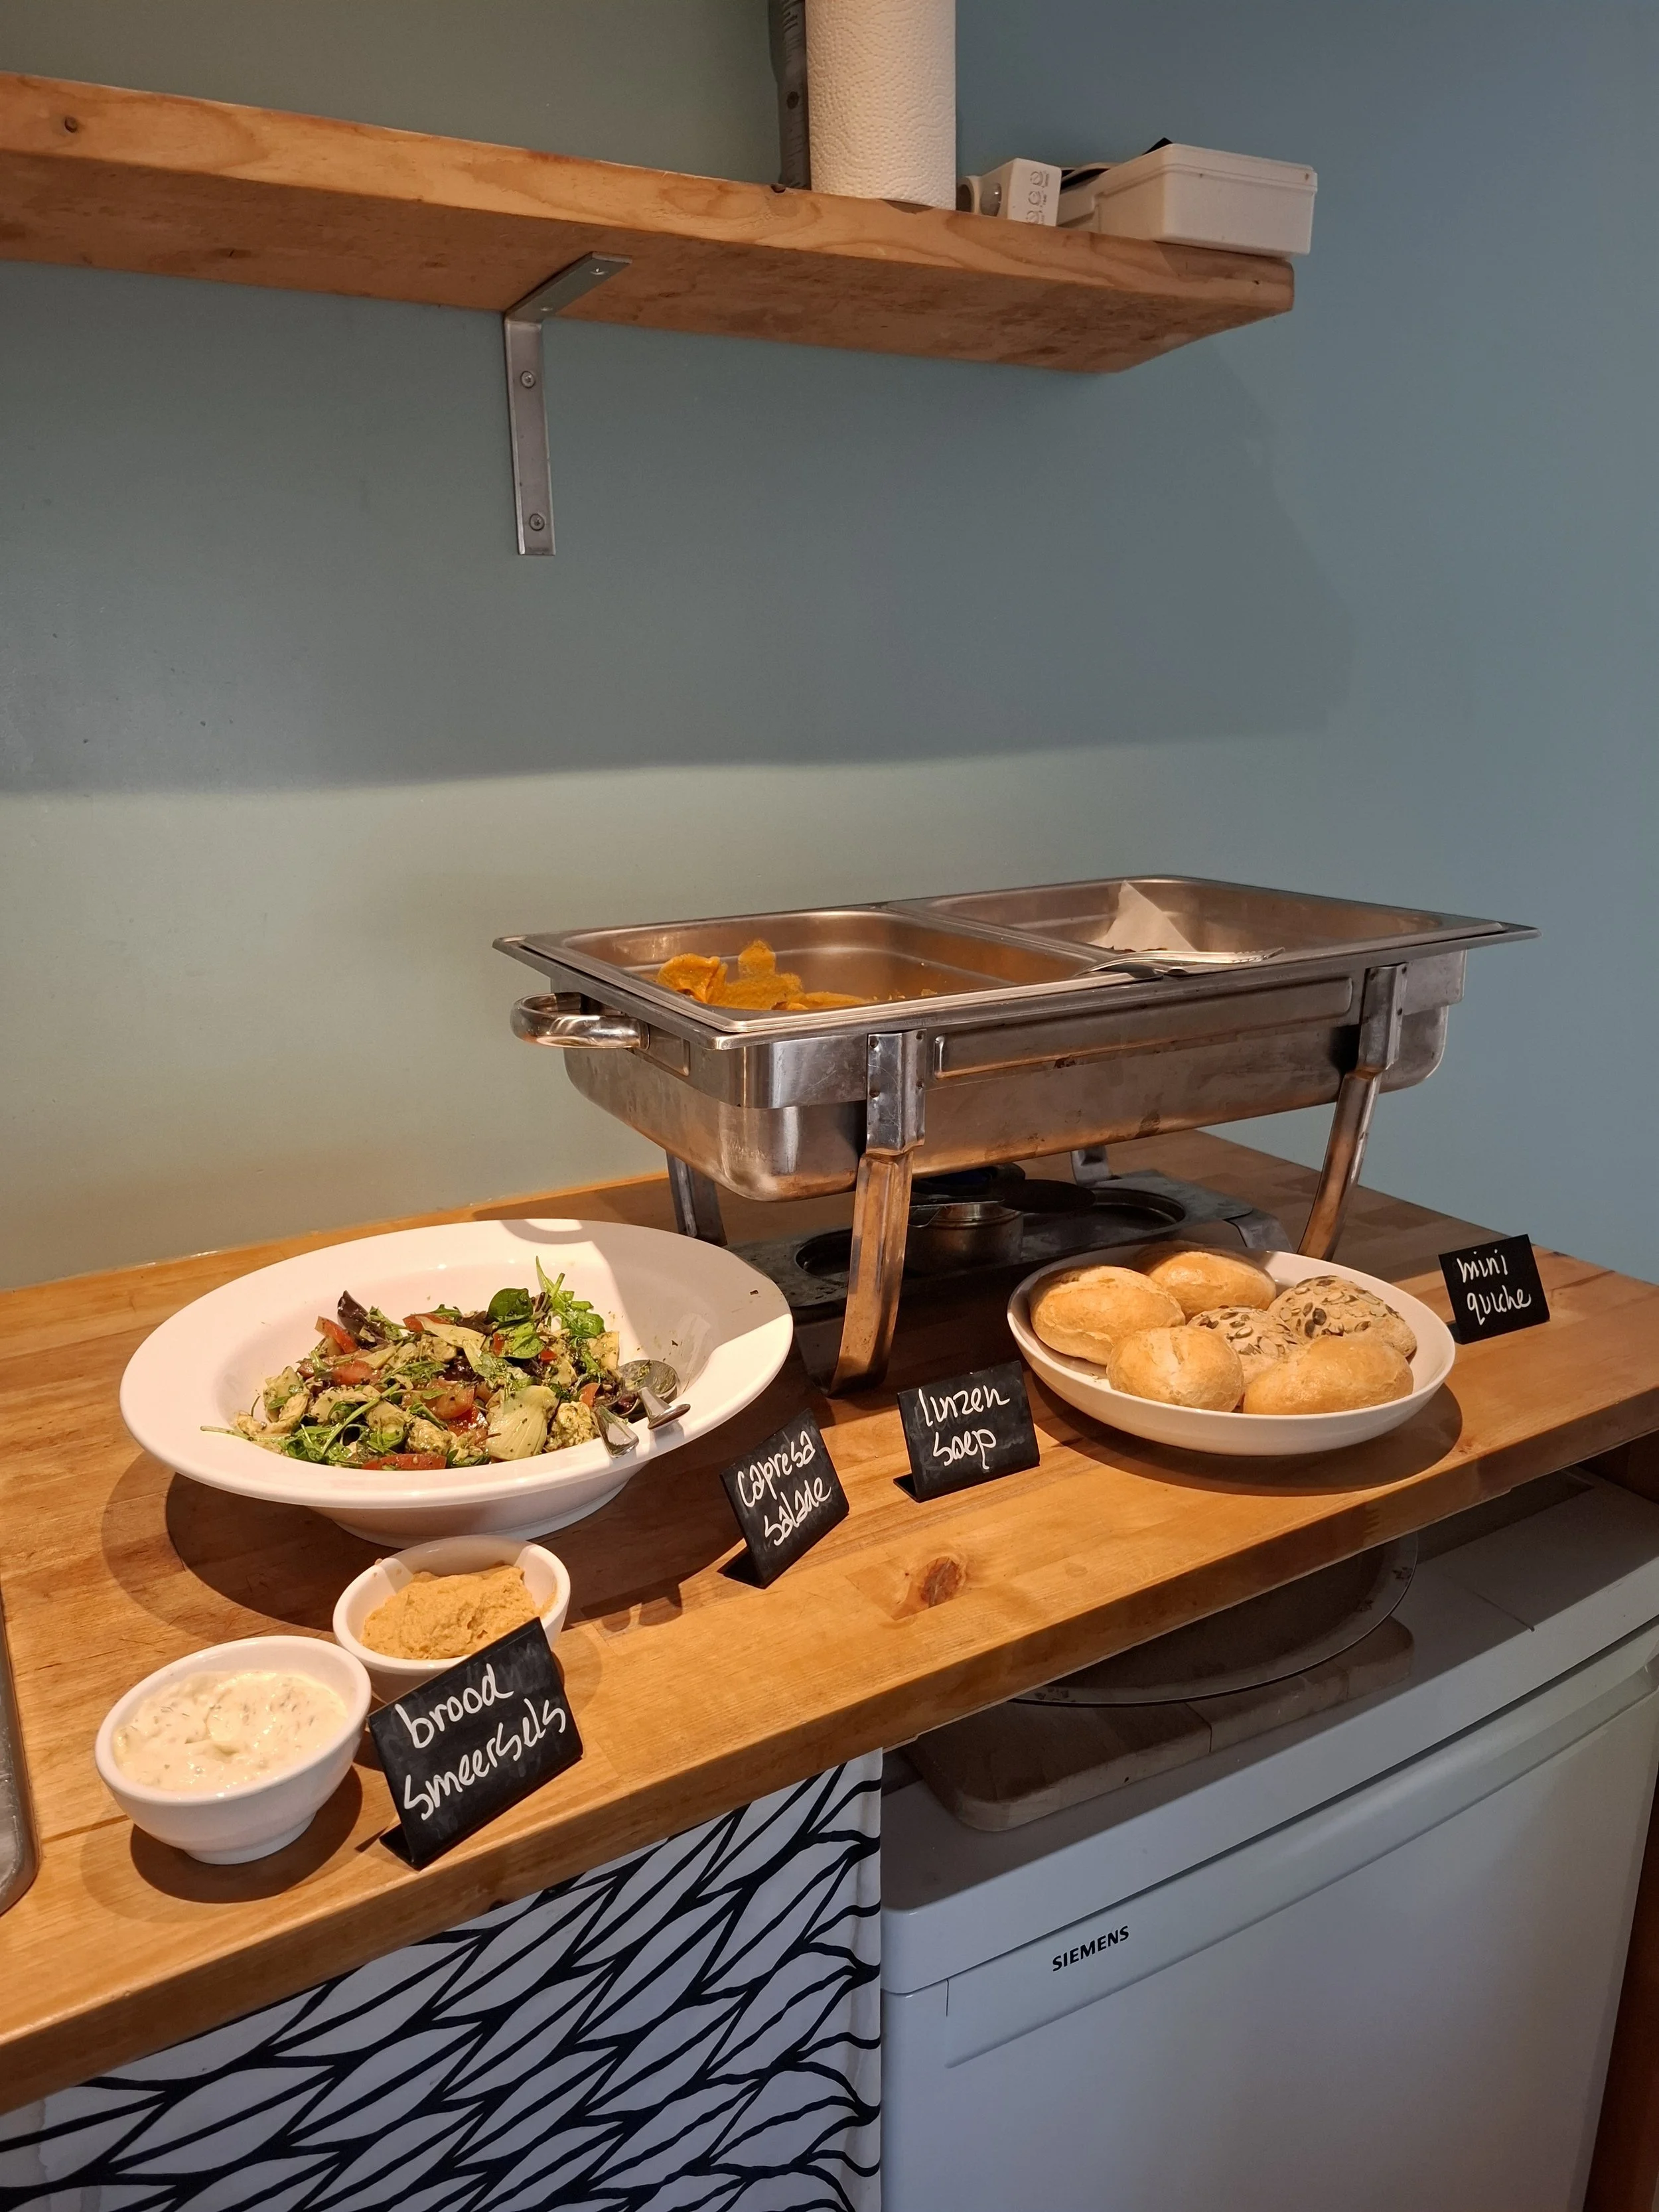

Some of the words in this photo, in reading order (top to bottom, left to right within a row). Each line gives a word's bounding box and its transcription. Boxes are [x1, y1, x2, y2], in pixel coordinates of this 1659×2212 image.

[1457, 1249, 1508, 1283] mini
[1467, 1285, 1532, 1325] quiche
[395, 1663, 514, 1749] brood
[1052, 1925, 1129, 1972] SIEMENS
